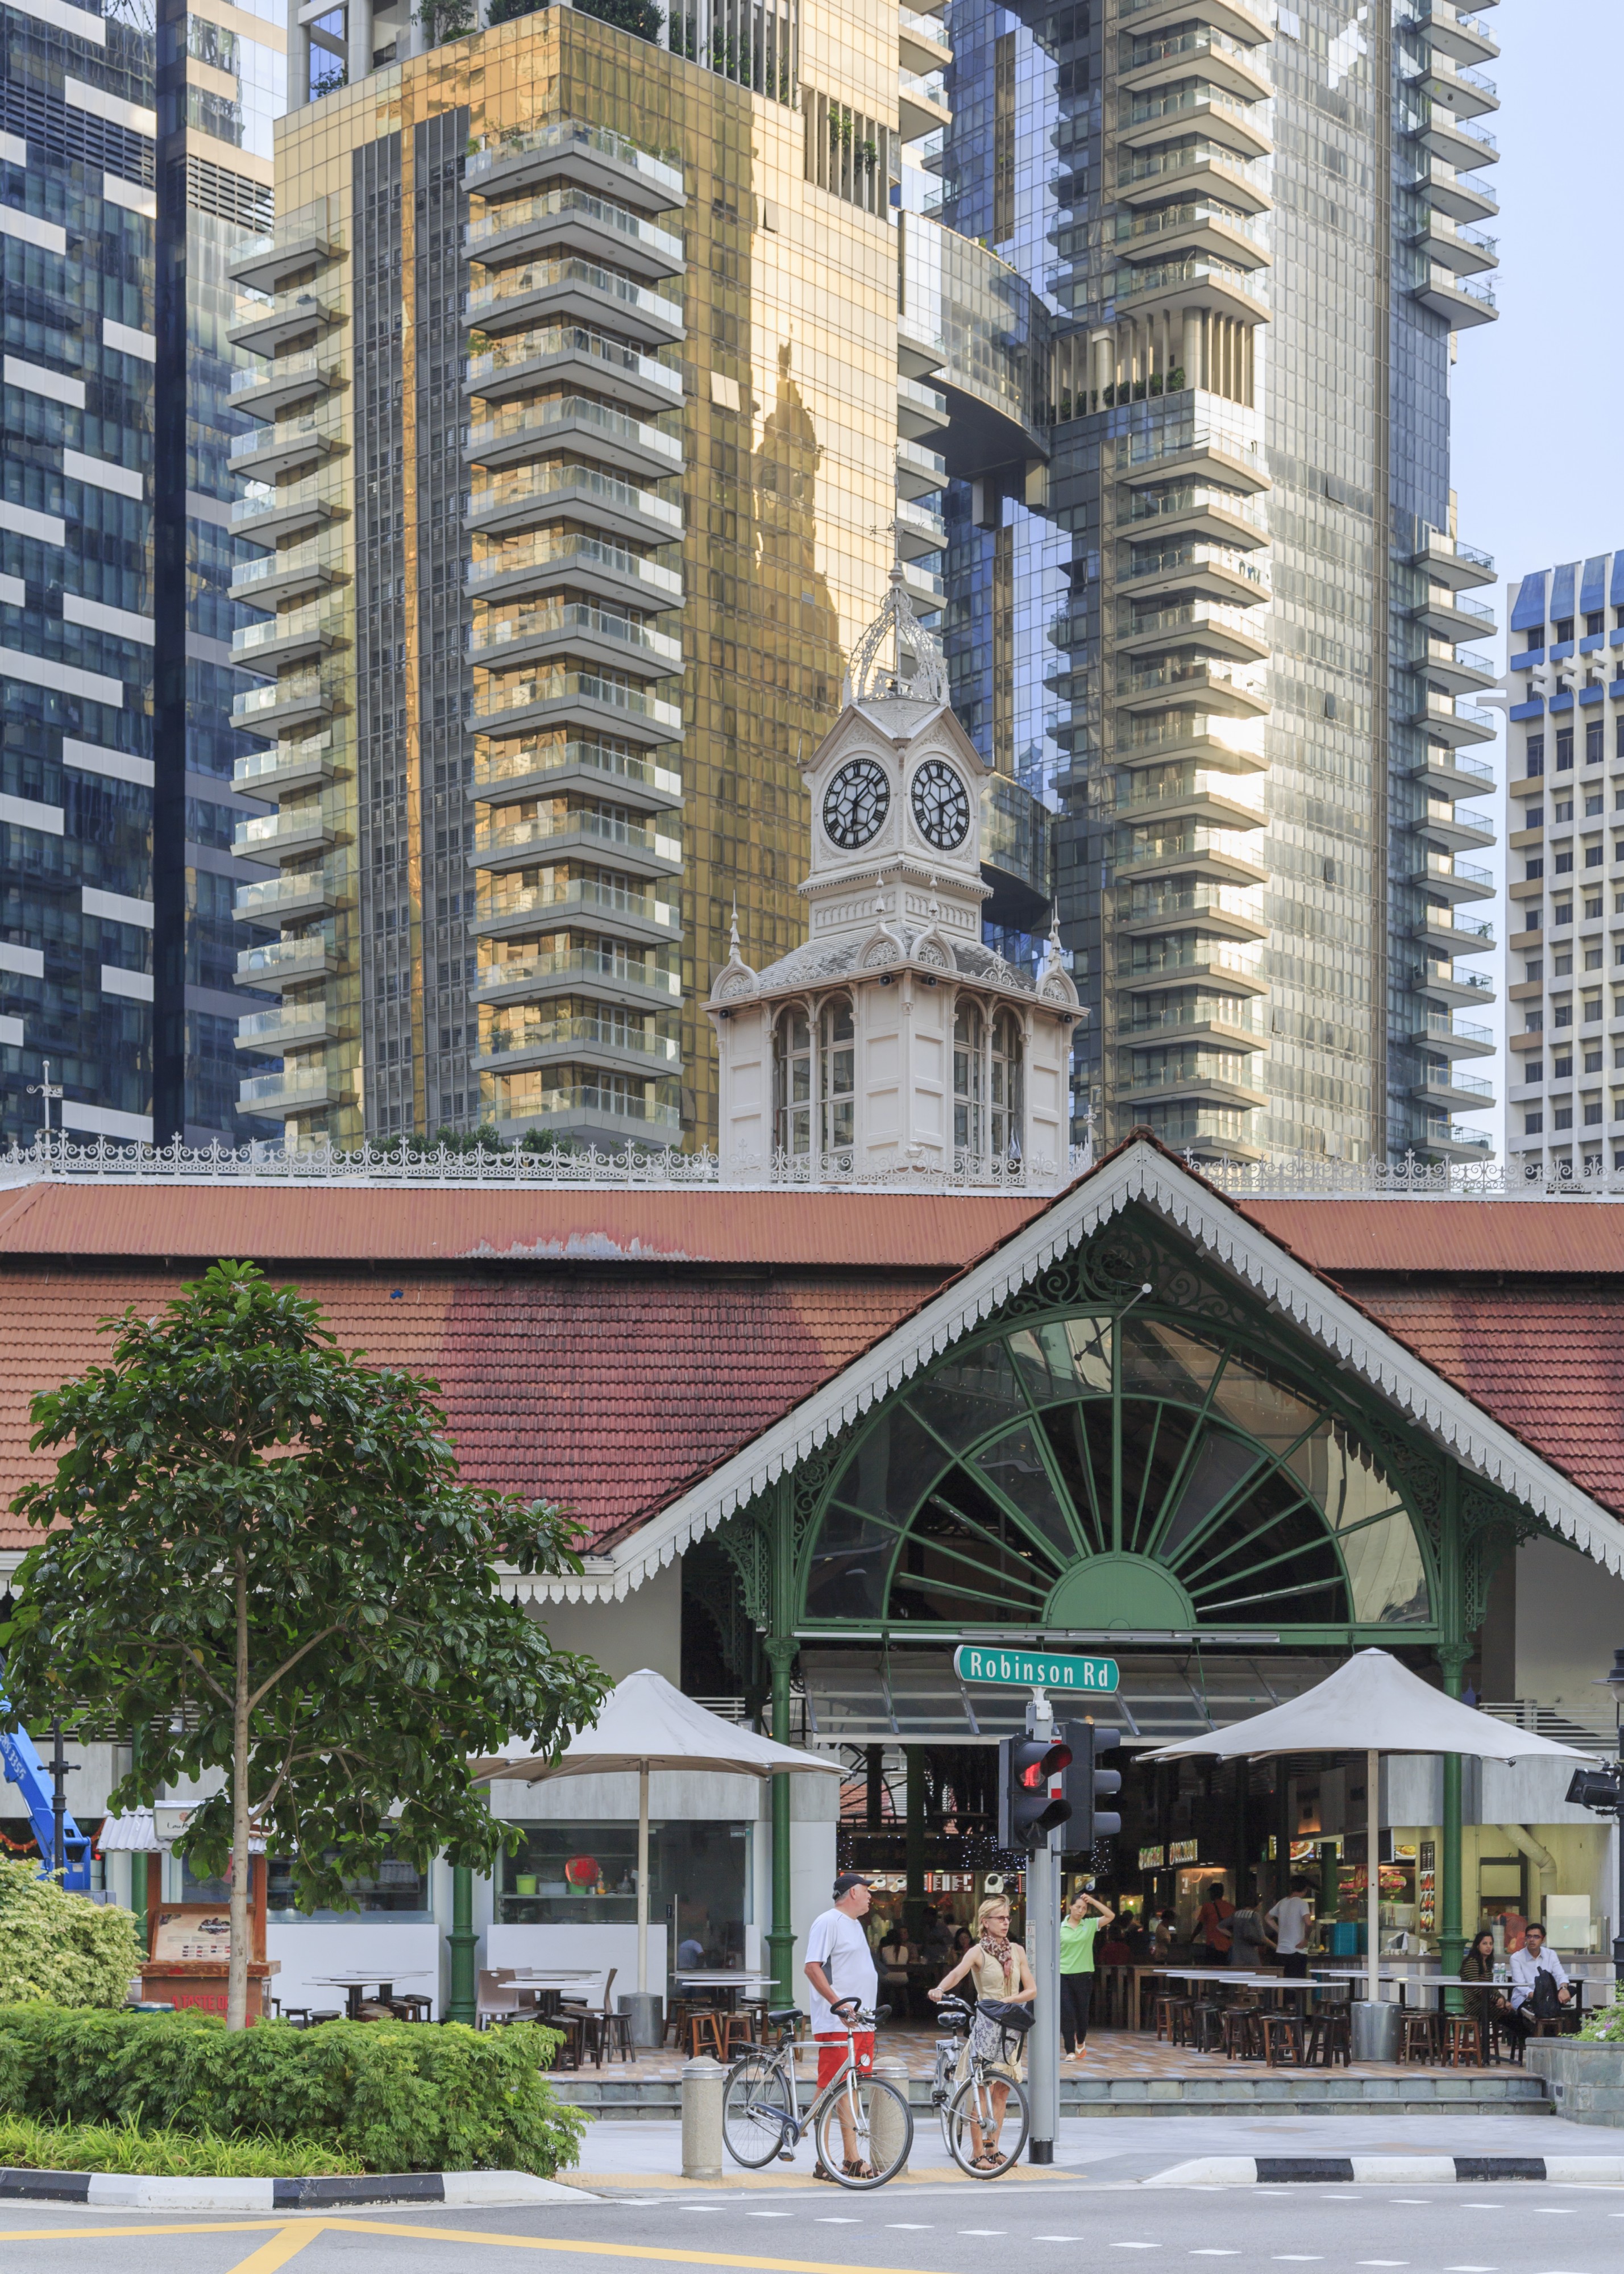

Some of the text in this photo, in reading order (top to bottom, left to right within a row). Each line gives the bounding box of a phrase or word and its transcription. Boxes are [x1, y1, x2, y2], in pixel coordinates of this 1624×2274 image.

[970, 1651, 1108, 1687] Robinson Rd
[172, 1995, 178, 2010] A
[181, 1995, 214, 2010] TASTE
